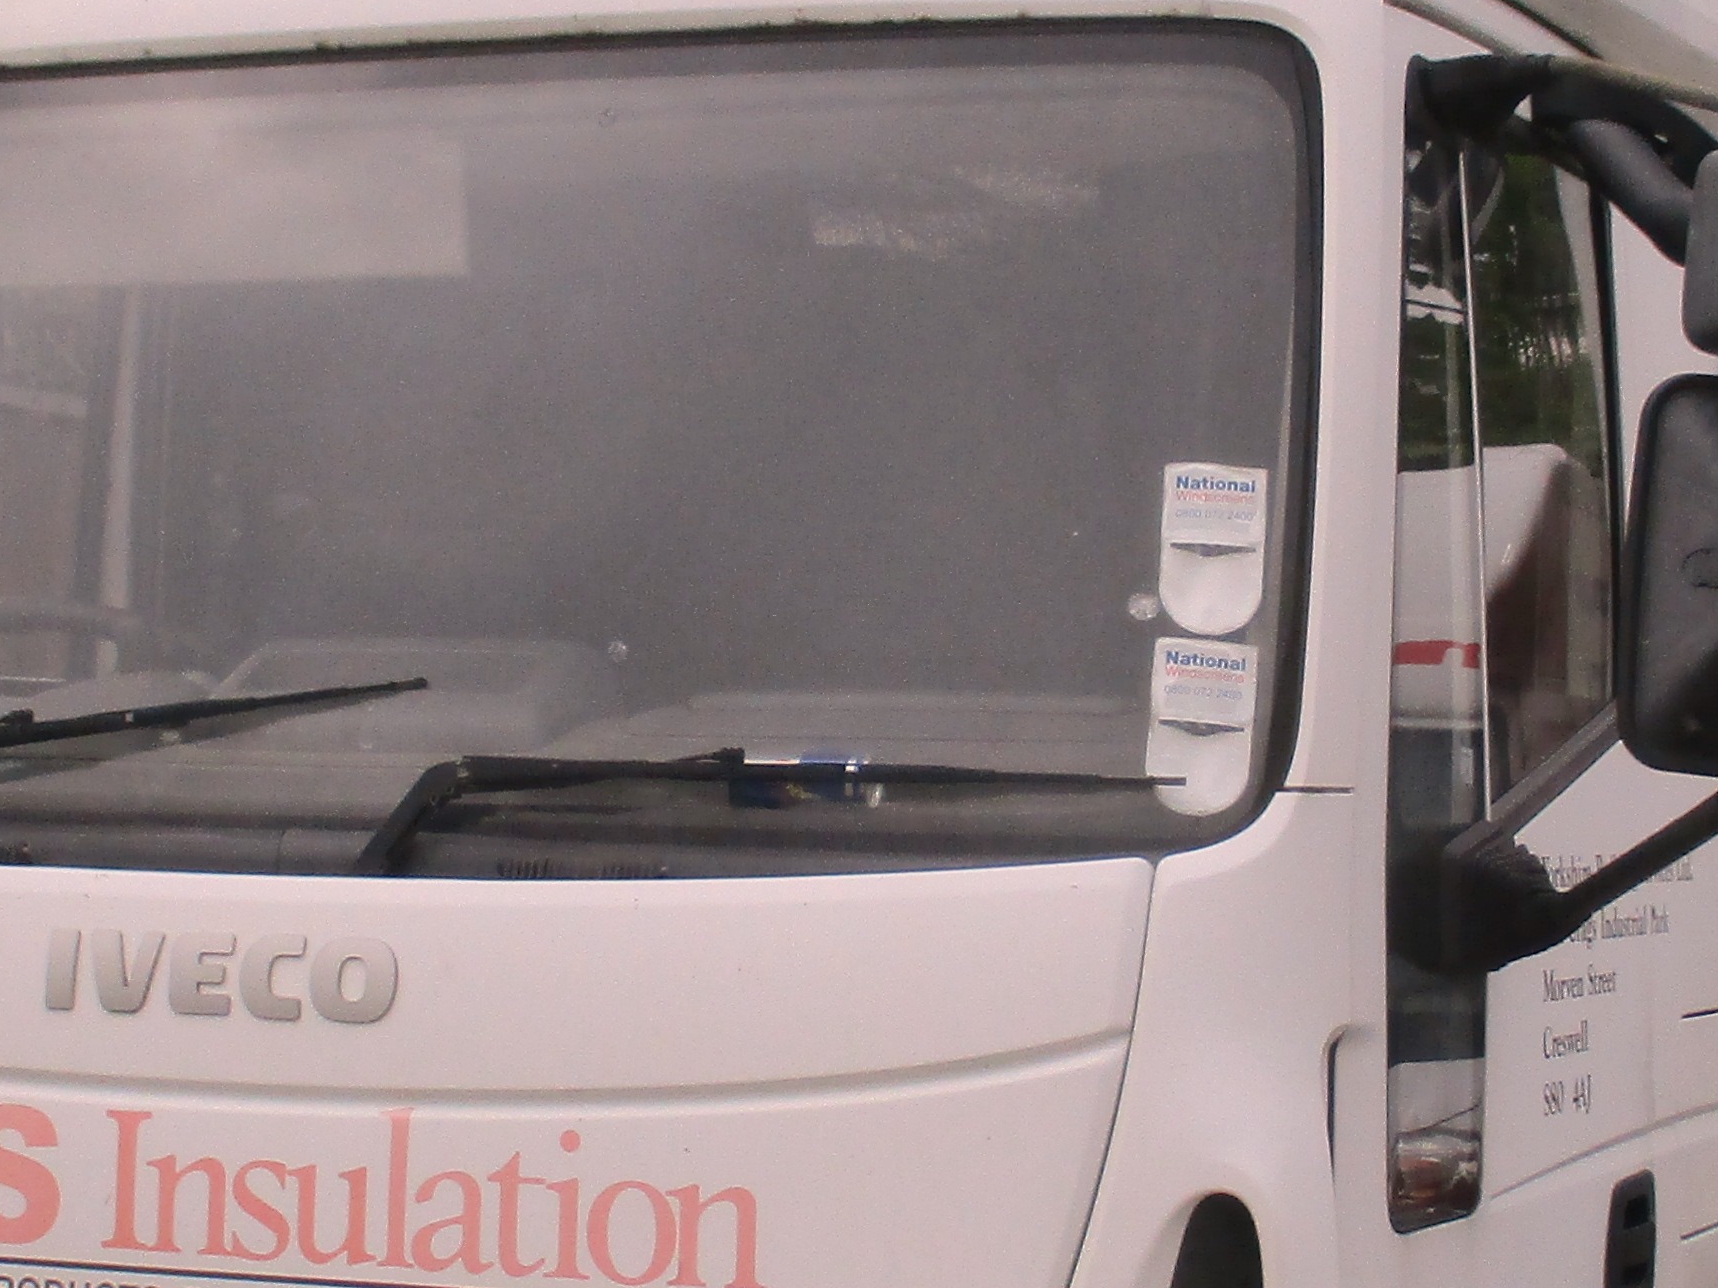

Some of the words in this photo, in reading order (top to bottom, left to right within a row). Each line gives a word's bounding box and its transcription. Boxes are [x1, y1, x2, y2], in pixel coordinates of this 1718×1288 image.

[1176, 475, 1255, 493] National
[1166, 650, 1246, 671] National
[43, 928, 400, 1025] IVECO
[1587, 962, 1617, 996] Street
